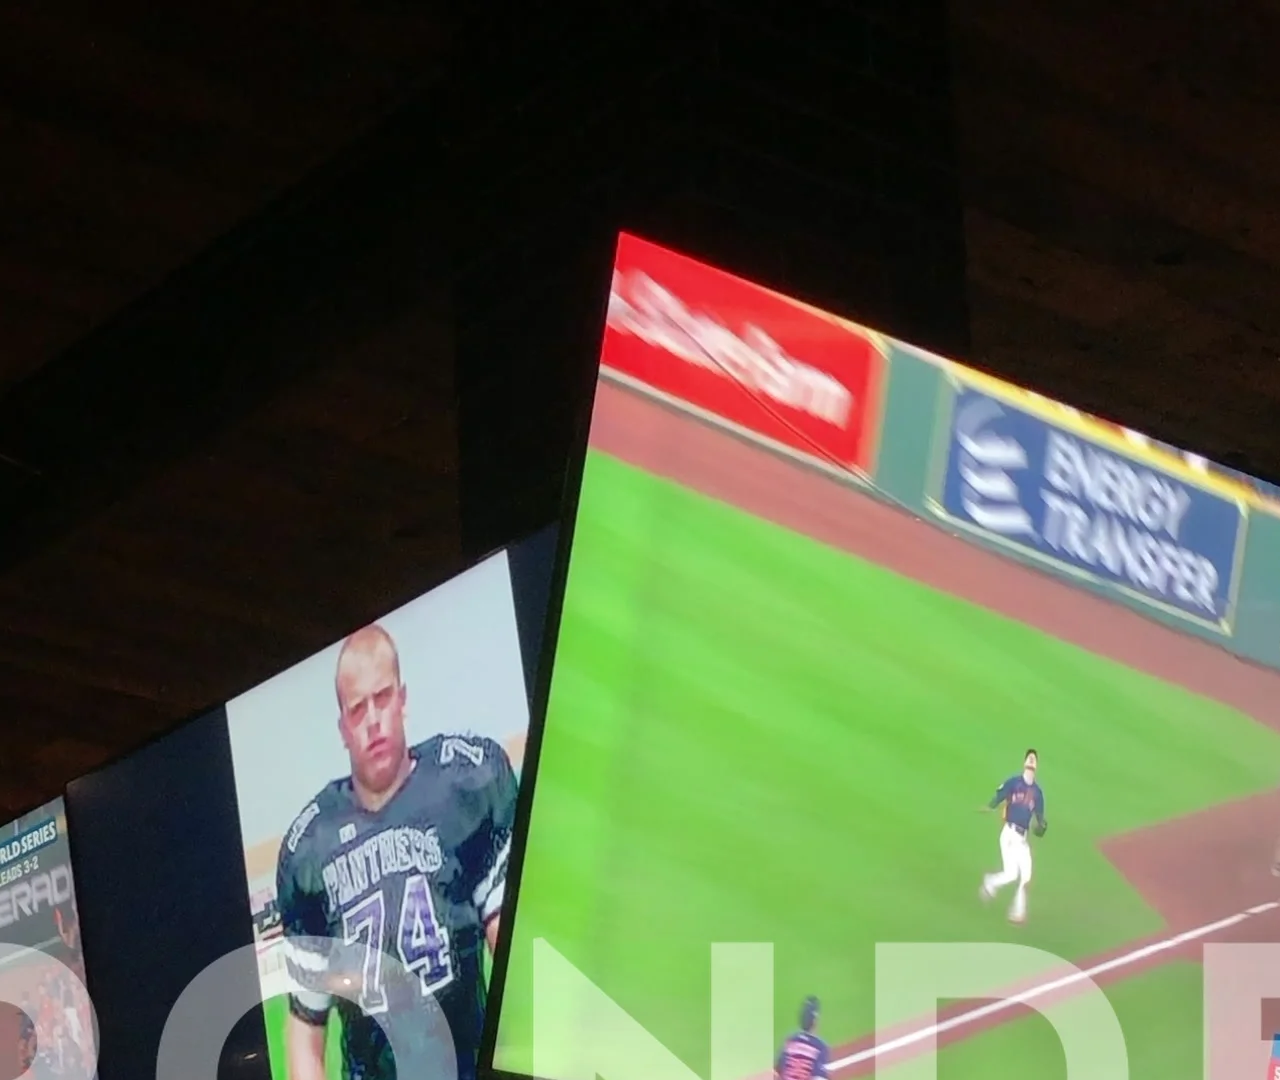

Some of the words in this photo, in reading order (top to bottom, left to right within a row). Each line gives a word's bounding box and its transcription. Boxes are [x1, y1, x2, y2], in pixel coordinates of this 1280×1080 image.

[1043, 428, 1191, 541] ENERGY
[1039, 487, 1219, 615] TRANSFER
[20, 821, 56, 854] SERIES
[23, 855, 39, 874] 3-2
[323, 826, 444, 912] PANTHERS
[341, 874, 454, 1017] 74
